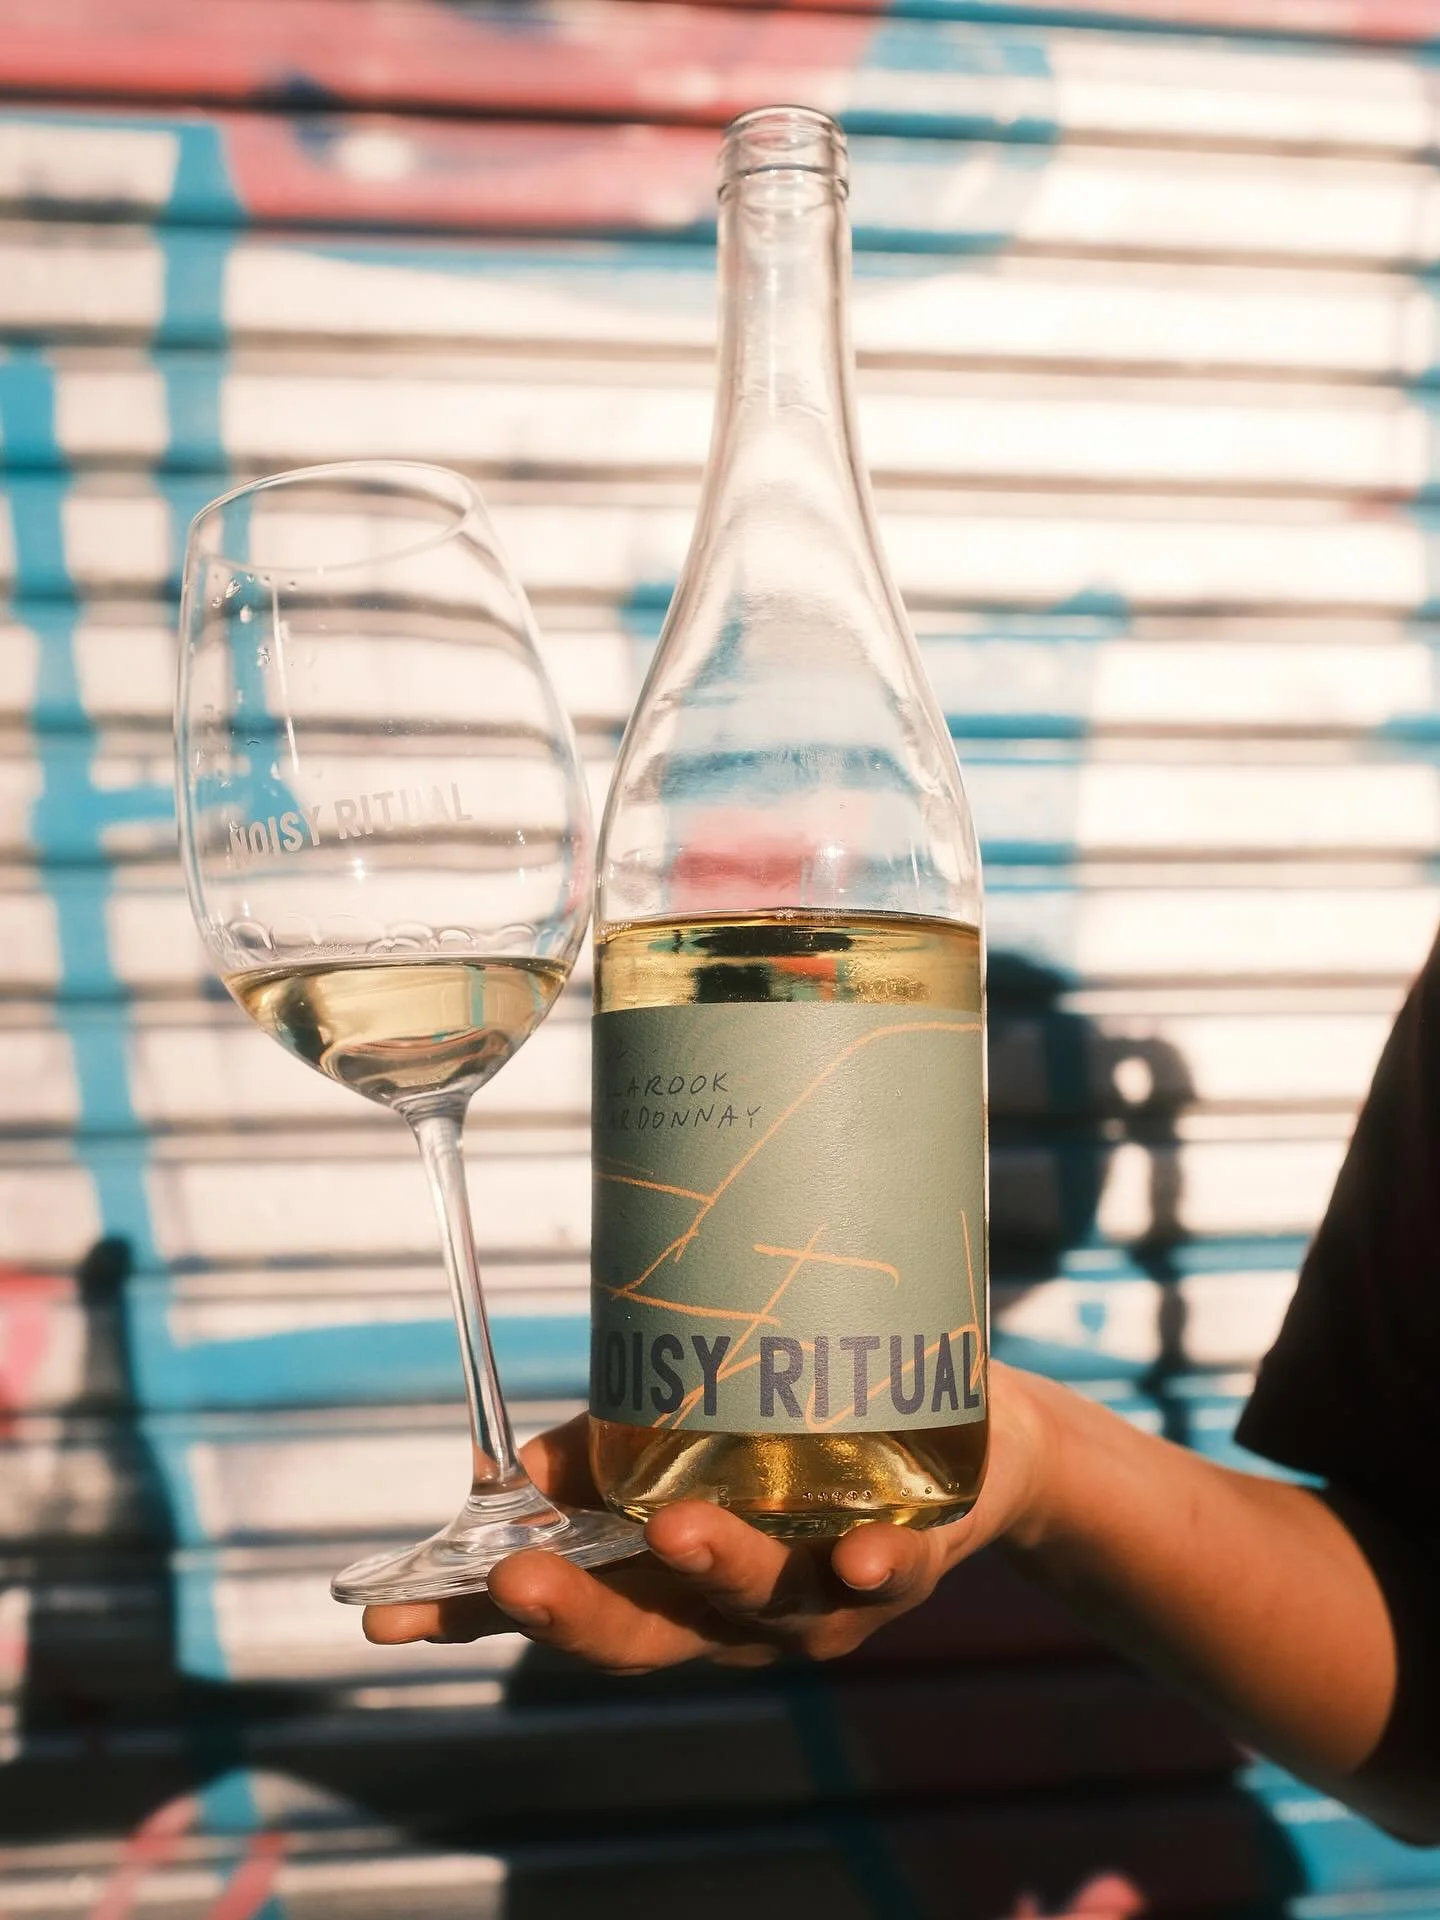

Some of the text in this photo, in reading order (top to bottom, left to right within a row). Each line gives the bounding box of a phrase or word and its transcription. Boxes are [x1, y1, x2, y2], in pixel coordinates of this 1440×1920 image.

[228, 783, 473, 868] NOISY RITUAL
[593, 1331, 984, 1418] OISY RITUAL
